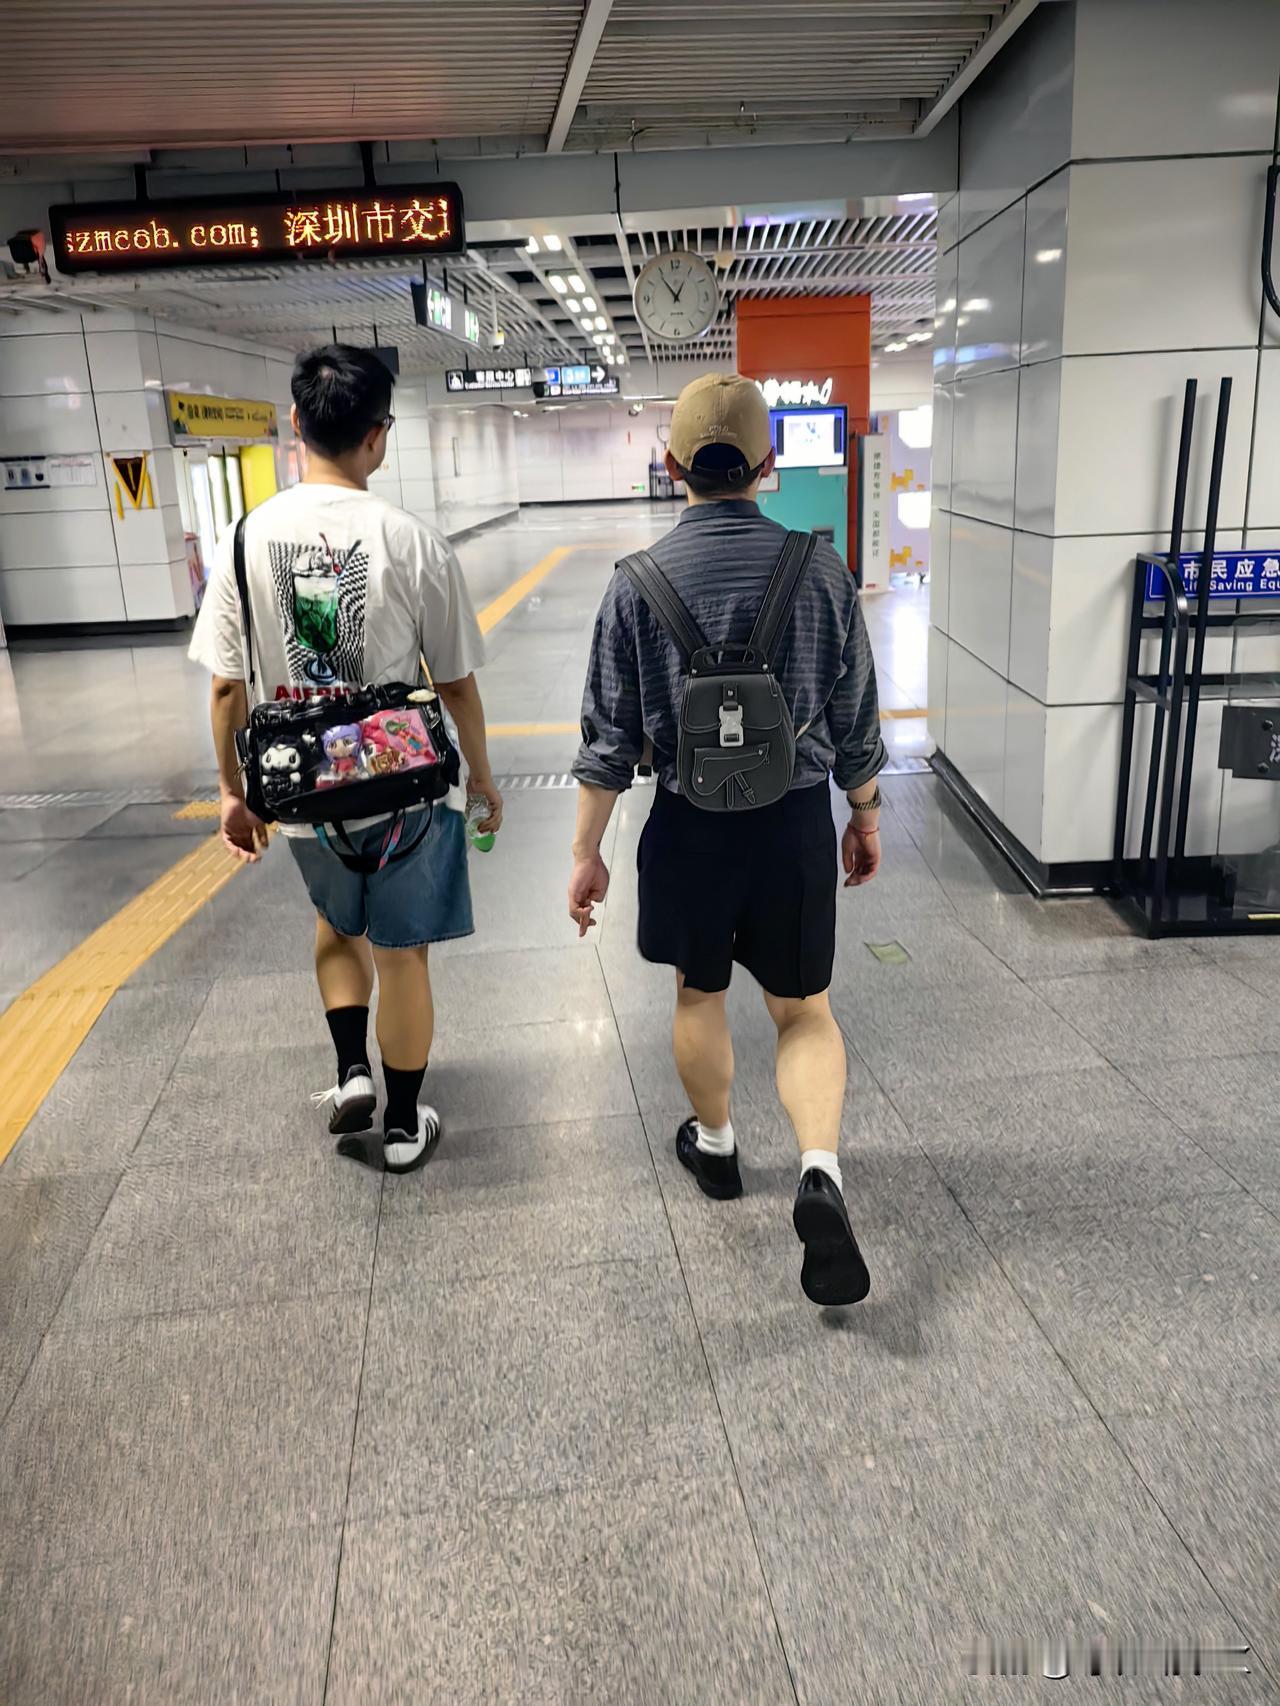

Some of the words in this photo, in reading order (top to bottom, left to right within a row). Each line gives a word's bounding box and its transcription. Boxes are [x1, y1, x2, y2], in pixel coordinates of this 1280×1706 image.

[1182, 557, 1280, 580] 市民应急
[1209, 579, 1253, 592] Saving
